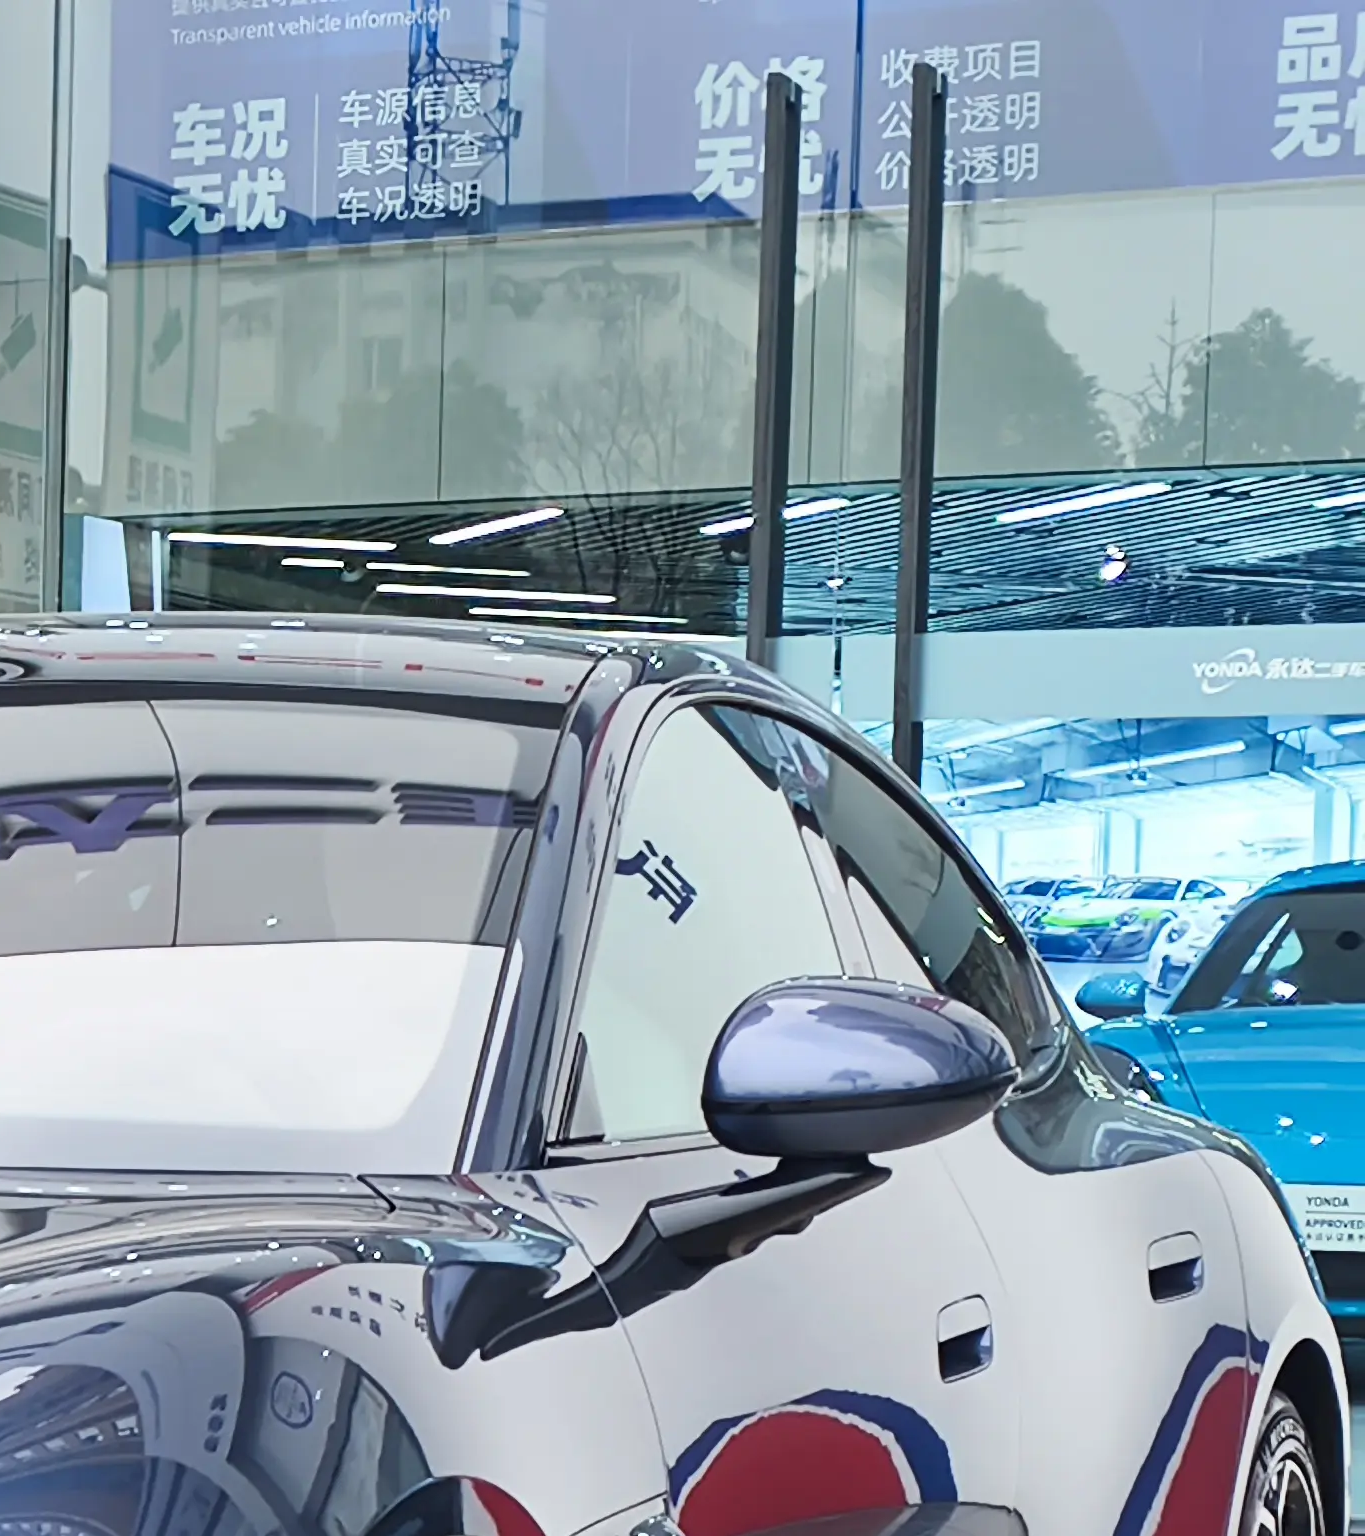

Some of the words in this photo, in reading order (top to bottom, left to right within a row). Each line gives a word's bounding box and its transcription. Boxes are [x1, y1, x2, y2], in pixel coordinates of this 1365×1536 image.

[171, 21, 275, 45] Transparent
[277, 14, 341, 37] vehicle
[345, 5, 451, 31] information
[880, 40, 1041, 89] 收费项目
[338, 81, 483, 128] 车源信息
[171, 97, 289, 166] 车况
[336, 130, 485, 178] 真实可查
[169, 167, 287, 237] 无忧
[336, 178, 482, 226] 车况透明
[1192, 661, 1263, 678] YONDA
[1306, 1196, 1349, 1208] YONDA
